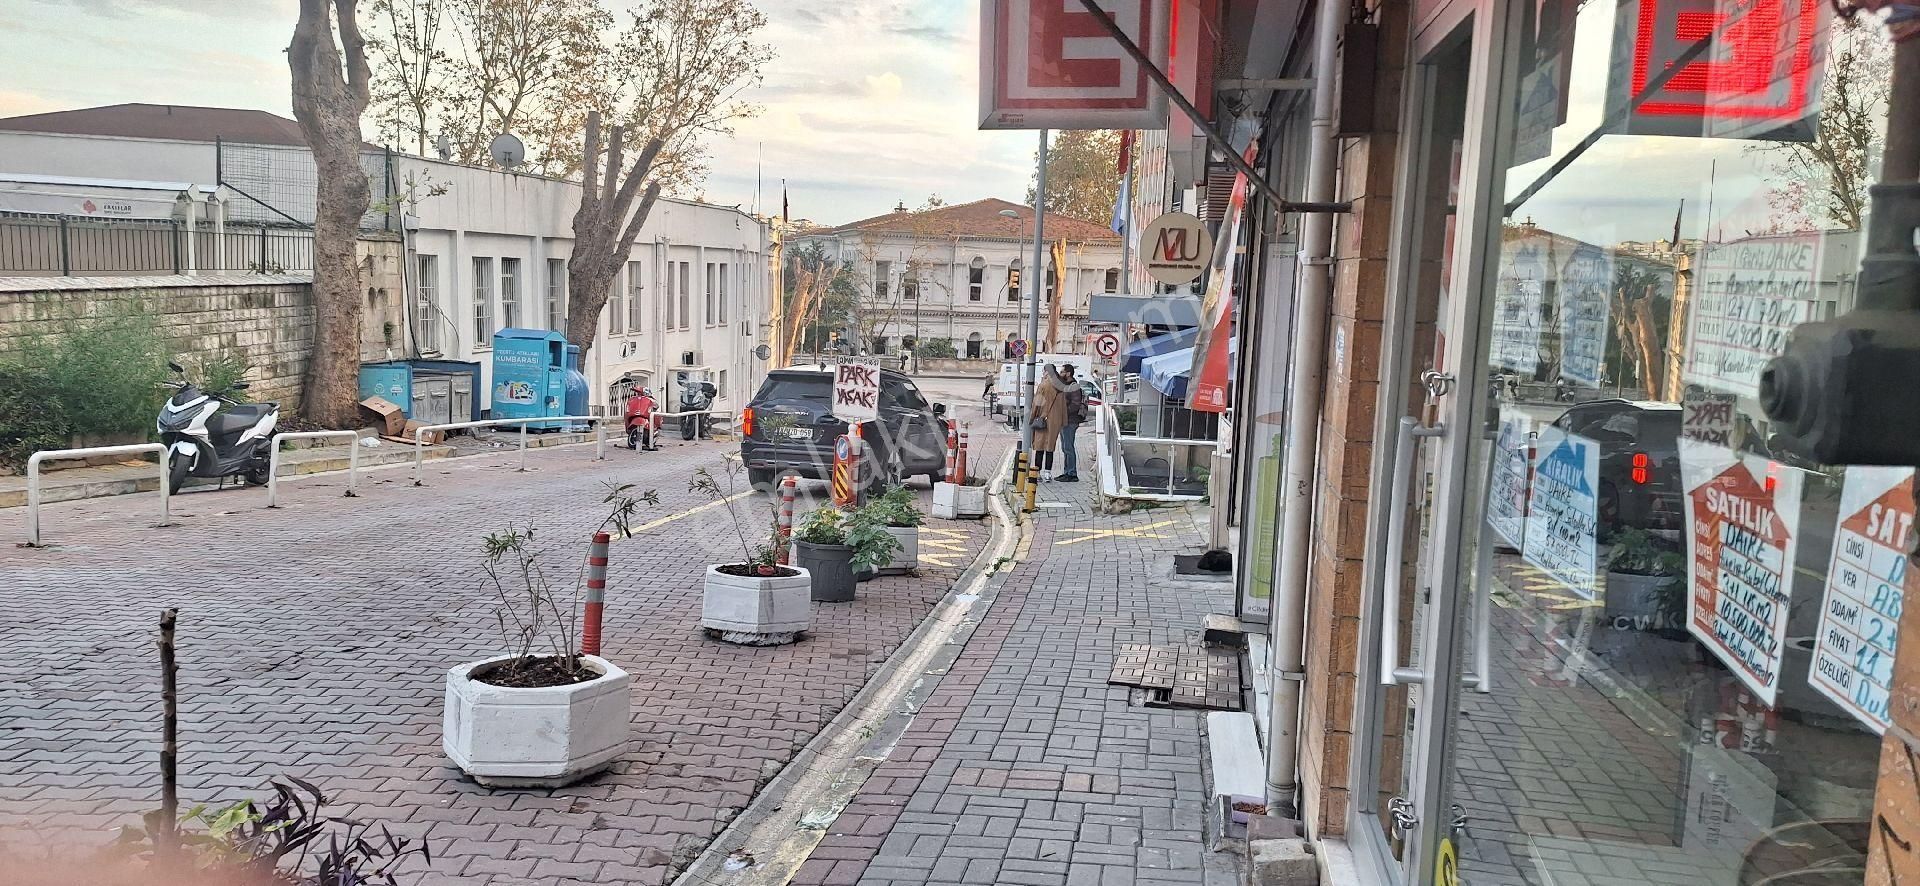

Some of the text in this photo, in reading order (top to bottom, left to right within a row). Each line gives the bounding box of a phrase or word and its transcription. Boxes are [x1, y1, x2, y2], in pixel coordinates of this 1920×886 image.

[496, 356, 539, 364] KUMBARASI
[837, 365, 877, 387] PARK
[1706, 487, 1774, 539] SATILIK
[1846, 537, 1865, 559] CİNSİ
[1843, 569, 1857, 589] YER
[1828, 628, 1850, 654] FİYAT
[1818, 654, 1850, 689] ÖZELLİĞİ
